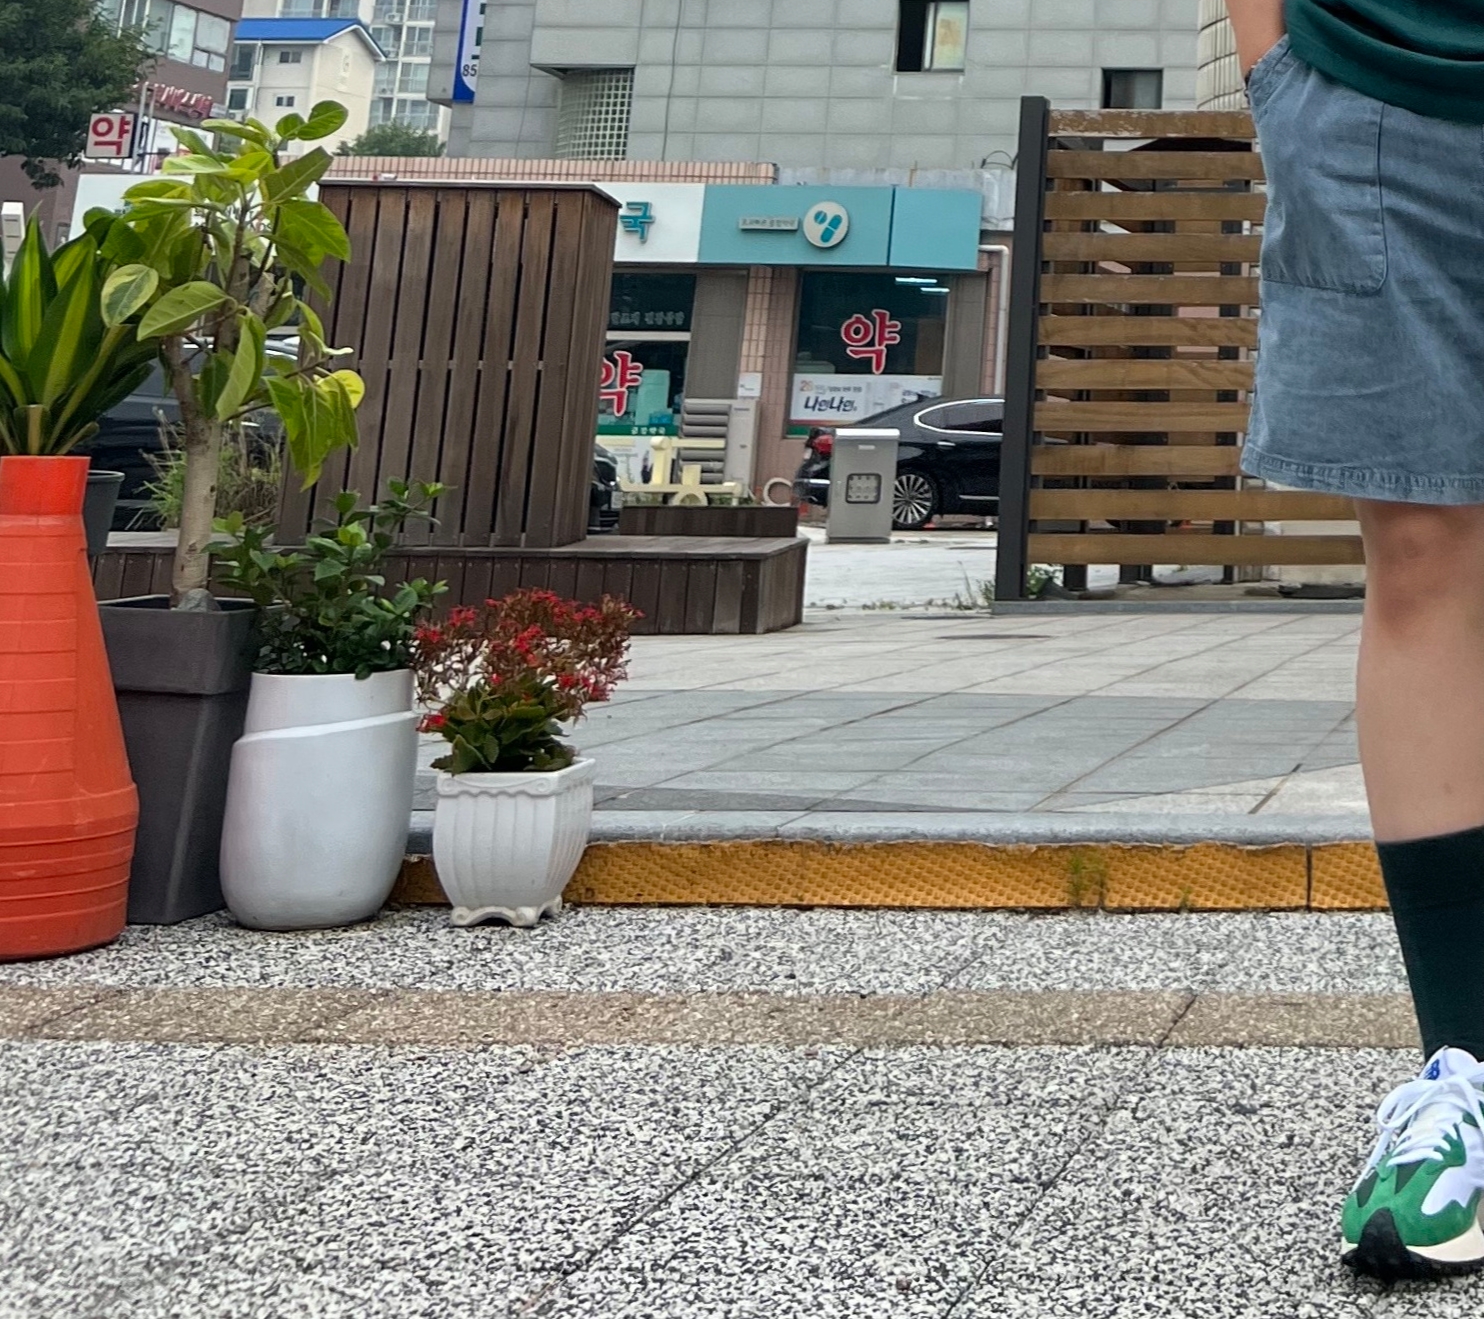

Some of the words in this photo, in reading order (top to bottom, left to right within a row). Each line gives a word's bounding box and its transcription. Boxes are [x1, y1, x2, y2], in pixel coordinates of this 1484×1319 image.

[91, 115, 131, 156] 약
[619, 202, 655, 244] 국
[841, 308, 901, 375] 약
[599, 351, 643, 417] 약
